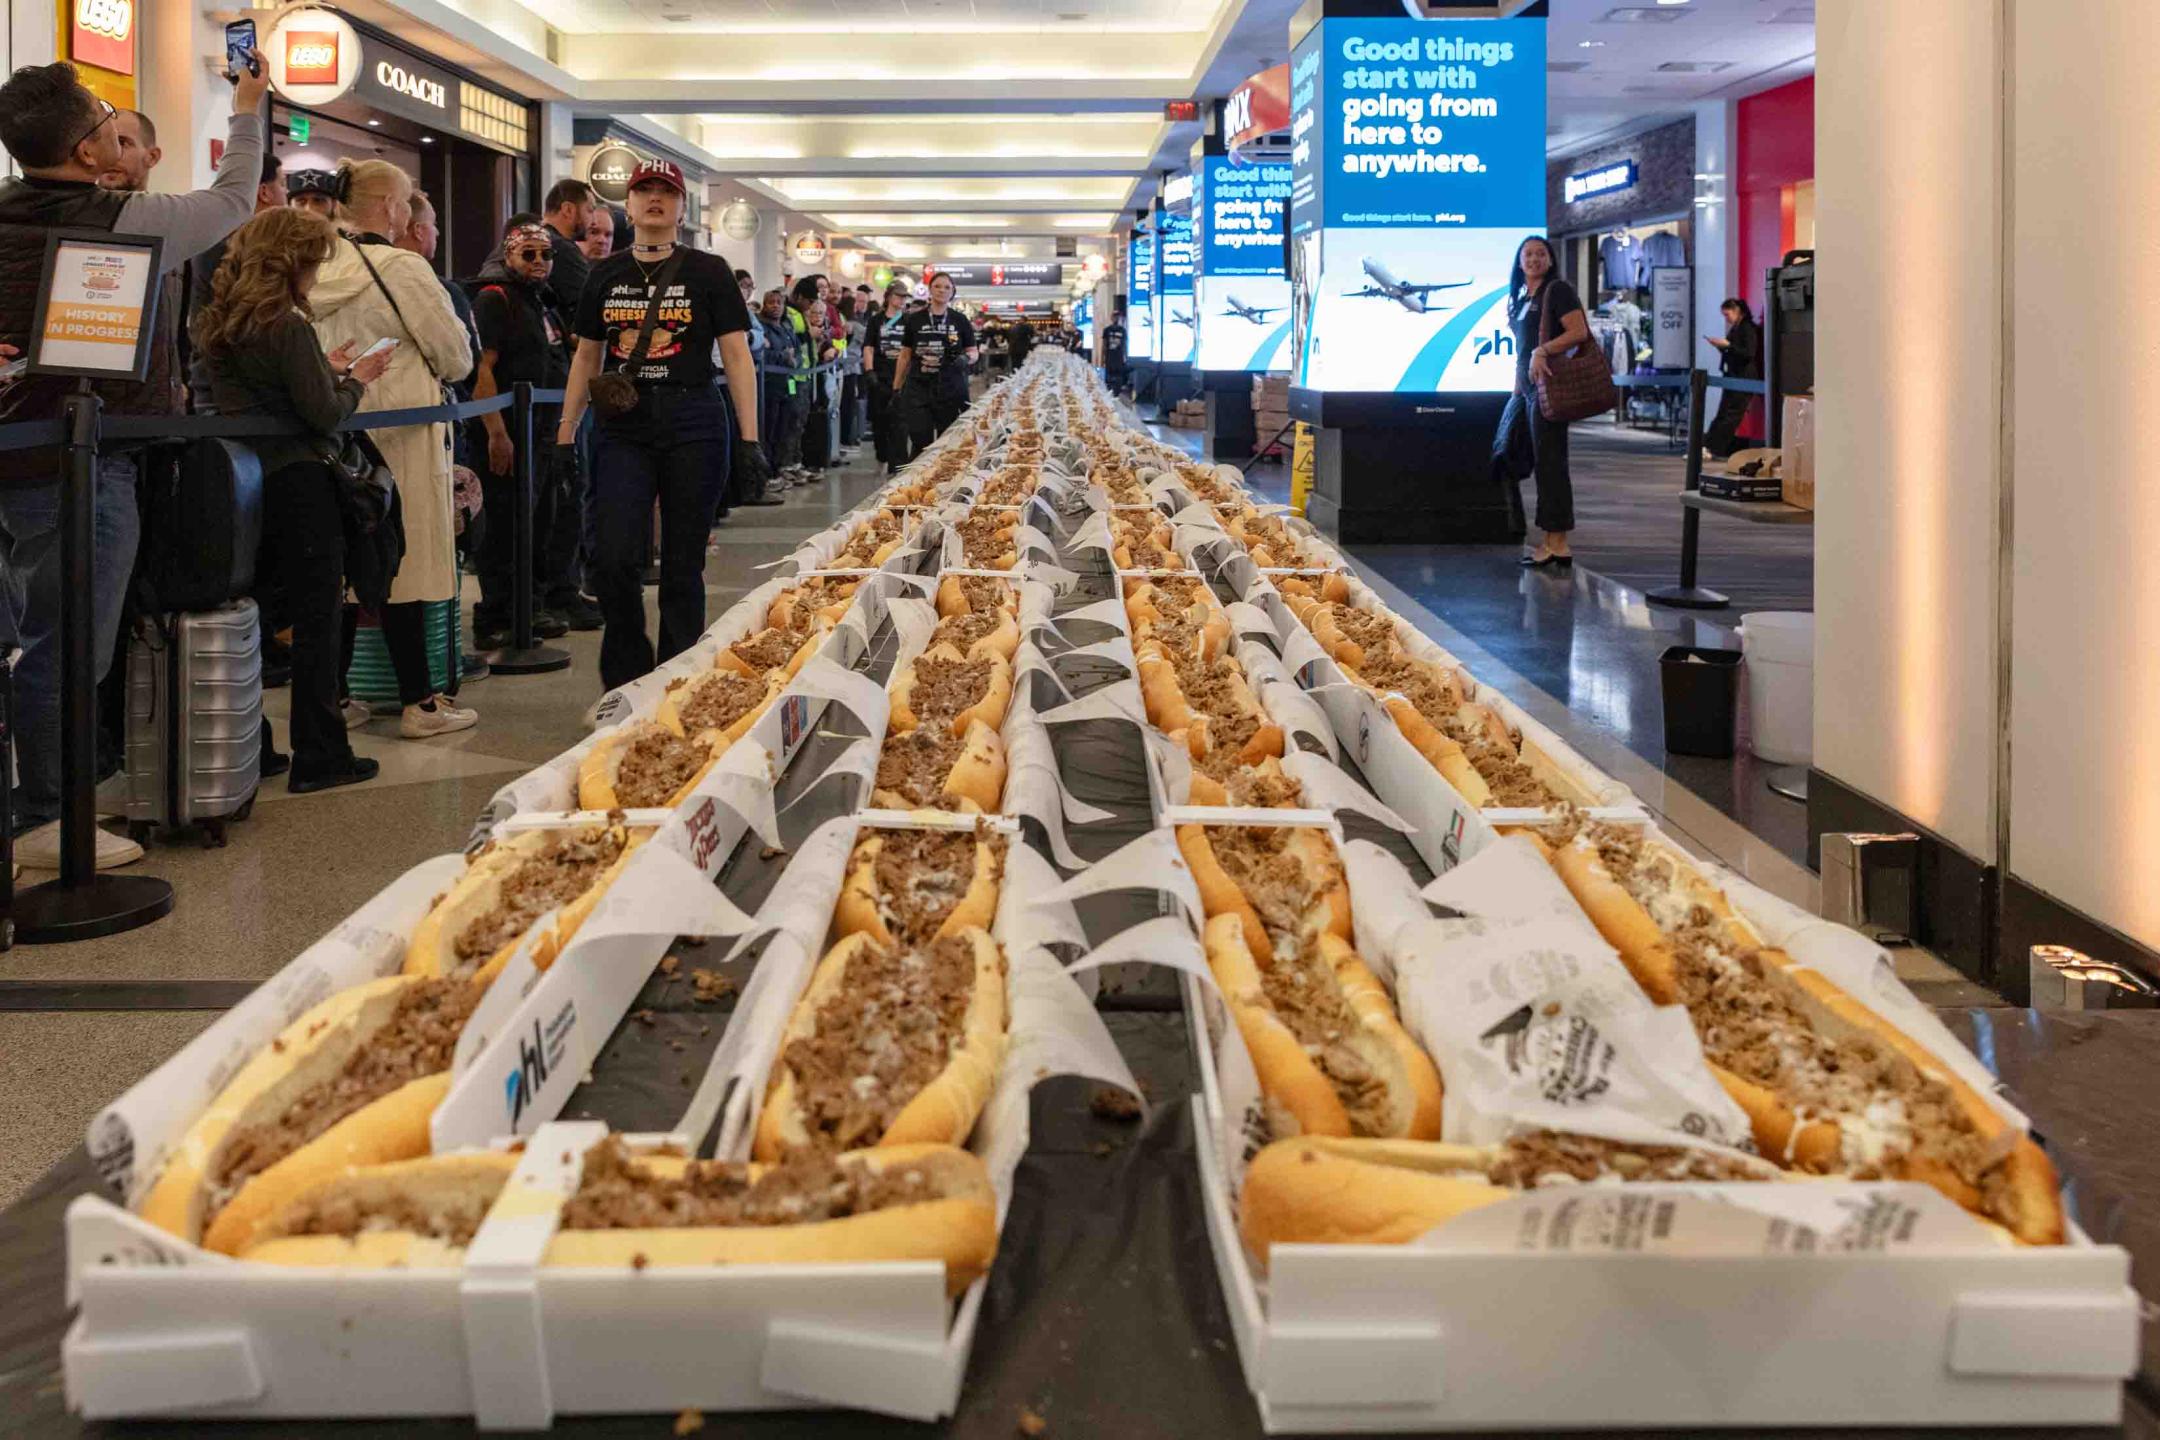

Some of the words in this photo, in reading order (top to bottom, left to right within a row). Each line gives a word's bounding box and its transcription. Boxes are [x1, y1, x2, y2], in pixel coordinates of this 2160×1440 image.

[78, 0, 131, 39] LEGO
[289, 45, 335, 67] LEGO
[1343, 37, 1420, 61] Good
[1425, 37, 1514, 67] things
[377, 61, 446, 109] COACH
[1342, 67, 1409, 89] start
[1414, 65, 1477, 89] with
[1343, 93, 1424, 122] going
[1429, 93, 1497, 117] from
[1343, 120, 1406, 145] here
[1411, 122, 1442, 145] to
[640, 159, 676, 177] PHL
[1342, 149, 1487, 178] anywhere.
[592, 173, 632, 182] COAC
[1214, 166, 1260, 182] Good
[1261, 166, 1293, 182] thin
[1214, 184, 1253, 198] start
[1213, 198, 1262, 217] going
[1214, 214, 1252, 230] here
[1253, 215, 1273, 230] to
[1213, 230, 1284, 249] anywher
[604, 299, 650, 309] LONGEST
[675, 299, 692, 308] OF
[65, 308, 127, 323] HISTORY
[1661, 320, 1682, 329] OFF
[47, 323, 63, 334] IN
[65, 323, 140, 339] PROGRESS
[1474, 330, 1513, 364] ph
